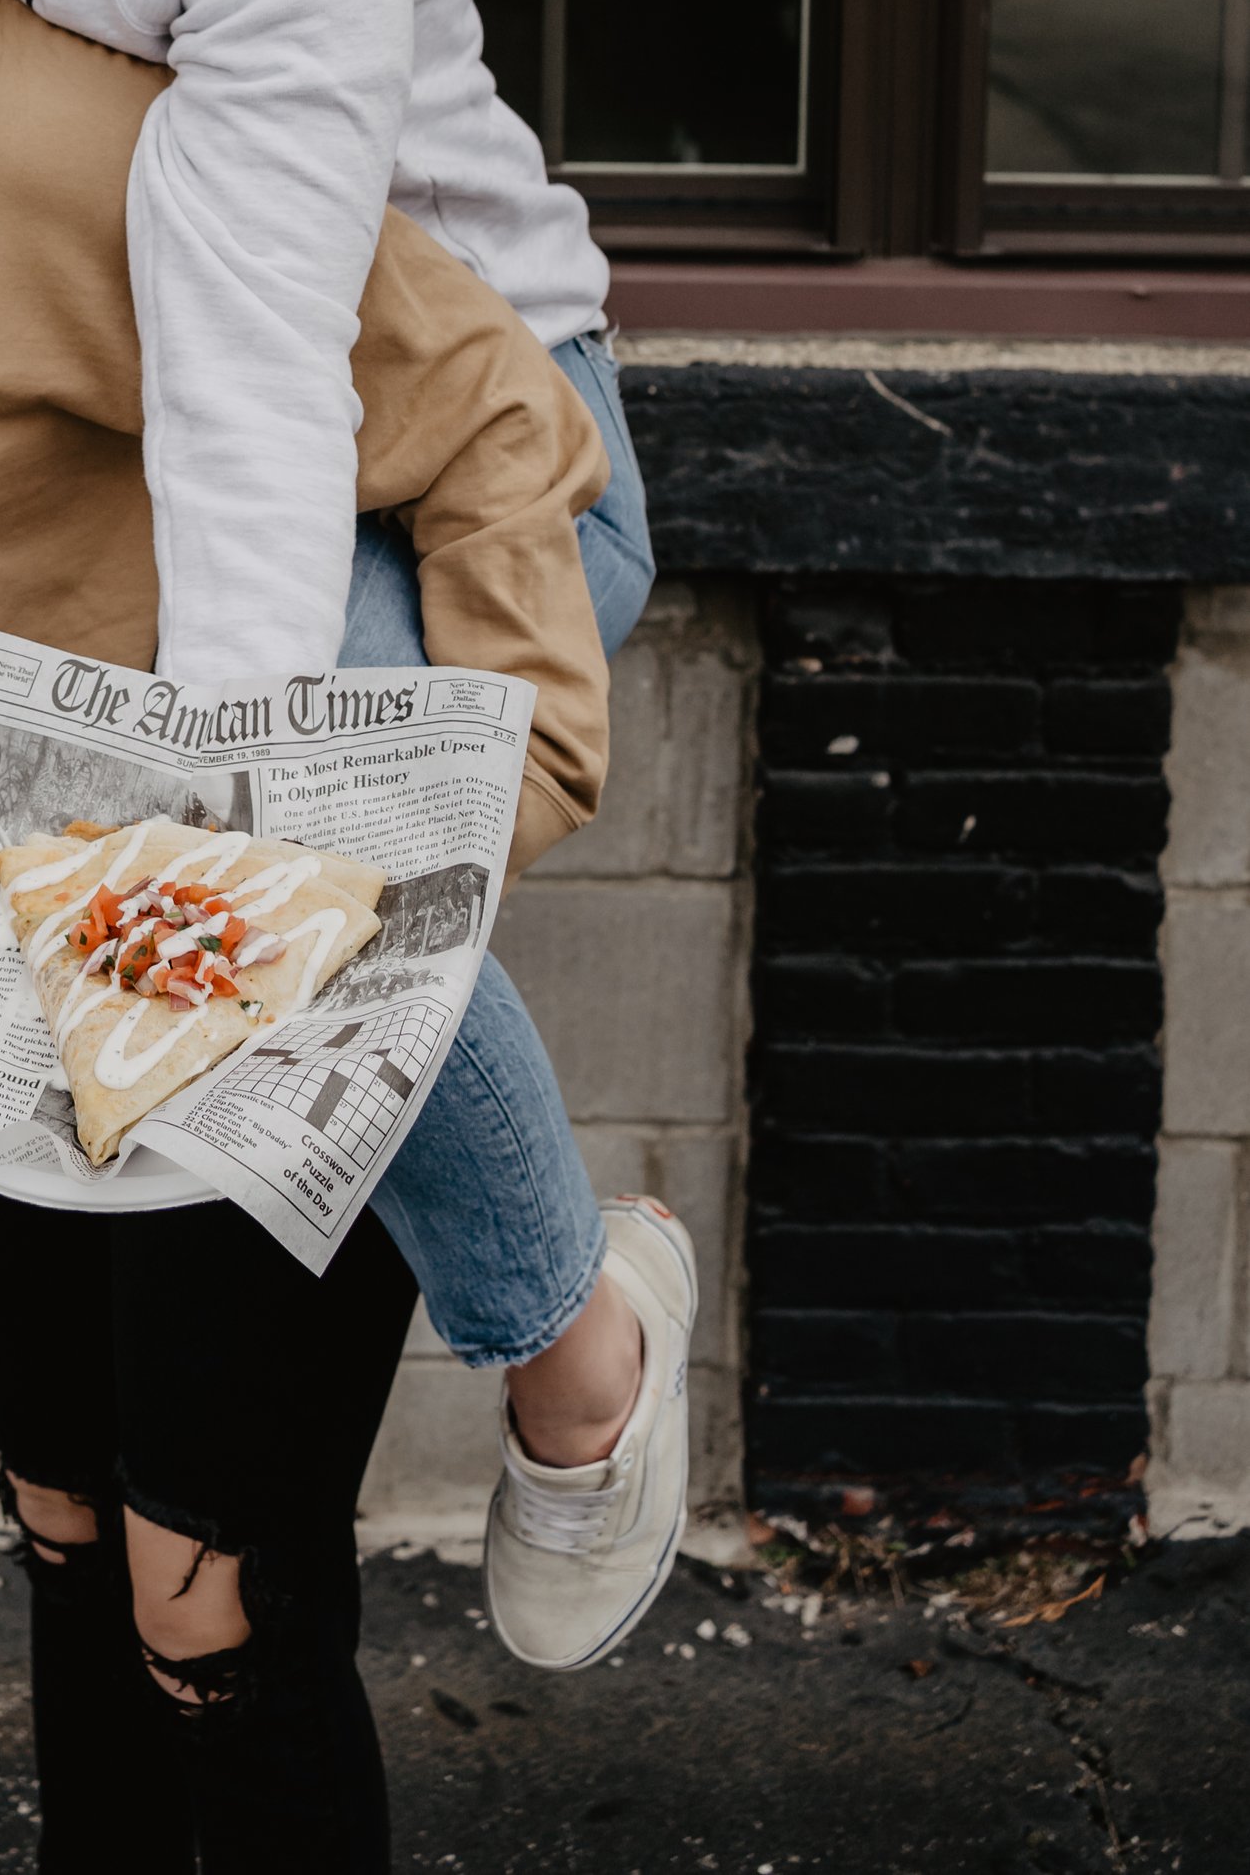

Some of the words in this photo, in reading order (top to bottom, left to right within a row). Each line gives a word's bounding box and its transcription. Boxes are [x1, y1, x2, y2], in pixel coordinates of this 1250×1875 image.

[0, 661, 16, 671] News
[16, 665, 34, 676] That
[451, 688, 481, 696] Chicago
[467, 682, 485, 690] York
[52, 659, 131, 729] The
[285, 673, 418, 736] Times
[456, 702, 485, 711] Angeles
[493, 730, 516, 742] $1.75
[237, 752, 249, 760] 19,
[252, 749, 271, 758] 1989
[268, 767, 298, 781] The
[303, 761, 338, 778] Most
[343, 741, 436, 769] Remarkable
[440, 739, 486, 757] Upset
[268, 790, 282, 803] in
[288, 778, 349, 802] Olympic
[354, 771, 410, 789] History
[270, 824, 302, 834] history
[307, 820, 320, 828] was
[324, 815, 337, 823] the
[341, 810, 361, 820] U.S.
[365, 804, 394, 817] hockey
[398, 799, 419, 809] team
[422, 791, 450, 803] defeat
[453, 787, 464, 795] of
[467, 787, 483, 795] the
[284, 810, 303, 819] One
[308, 807, 317, 816] of
[318, 804, 332, 813] the
[336, 799, 358, 808] most
[362, 788, 415, 805] remarkable
[419, 781, 448, 792] upsets
[337, 834, 365, 845] Winter
[367, 829, 394, 839] Games
[405, 820, 426, 829] Lake
[428, 813, 456, 825] Placid,
[458, 809, 476, 818] New
[340, 816, 391, 833] gold-medal
[395, 808, 430, 820] winning
[433, 800, 462, 812] Soviet
[467, 799, 491, 809] team
[370, 847, 412, 862] American
[416, 841, 438, 852] team
[457, 830, 488, 842] before
[383, 831, 425, 847] regarded
[443, 825, 457, 834] the
[426, 852, 440, 862] the
[445, 841, 495, 857] Americans
[8, 956, 26, 965] War
[7, 1086, 35, 1098] search
[221, 1089, 259, 1104] Diagnostic
[260, 1100, 275, 1111] test
[212, 1097, 227, 1107] Flip
[227, 1102, 244, 1113] Flop
[205, 1108, 218, 1116] Pro
[228, 1118, 241, 1128] con
[209, 1103, 237, 1119] Sandler
[252, 1122, 264, 1134] Big
[194, 1126, 203, 1135] By
[205, 1132, 219, 1143] way
[220, 1141, 230, 1149] of
[197, 1120, 214, 1132] Aug.
[215, 1128, 245, 1149] follower
[242, 1135, 257, 1148] lake
[302, 1135, 355, 1185] Crossword
[302, 1158, 334, 1193] Puzzle
[284, 1169, 299, 1182] of
[297, 1177, 313, 1198] the
[312, 1192, 333, 1217] Day
